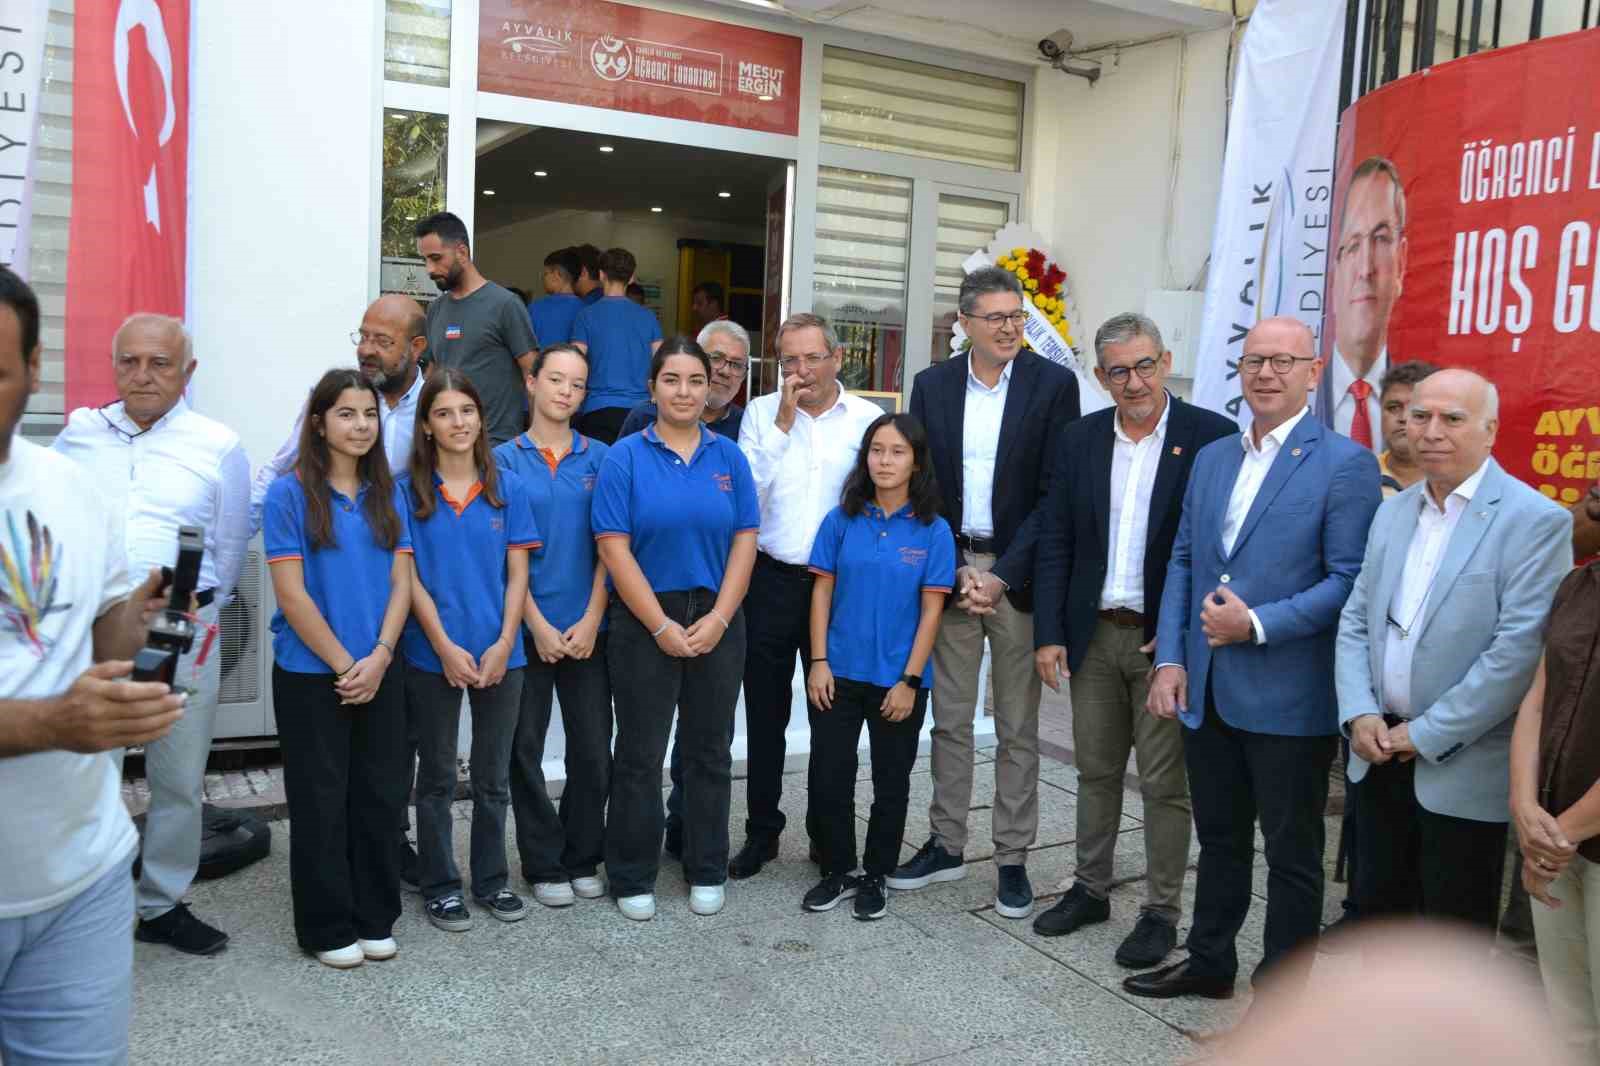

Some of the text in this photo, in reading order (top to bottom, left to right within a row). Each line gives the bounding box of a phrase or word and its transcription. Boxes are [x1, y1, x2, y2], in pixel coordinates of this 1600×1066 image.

[501, 21, 573, 41] AYVALIK
[738, 61, 784, 81] MESUT
[738, 75, 782, 97] ERGİN
[1459, 126, 1576, 204] ÖĞRENCİ
[1447, 225, 1540, 353] HOŞ
